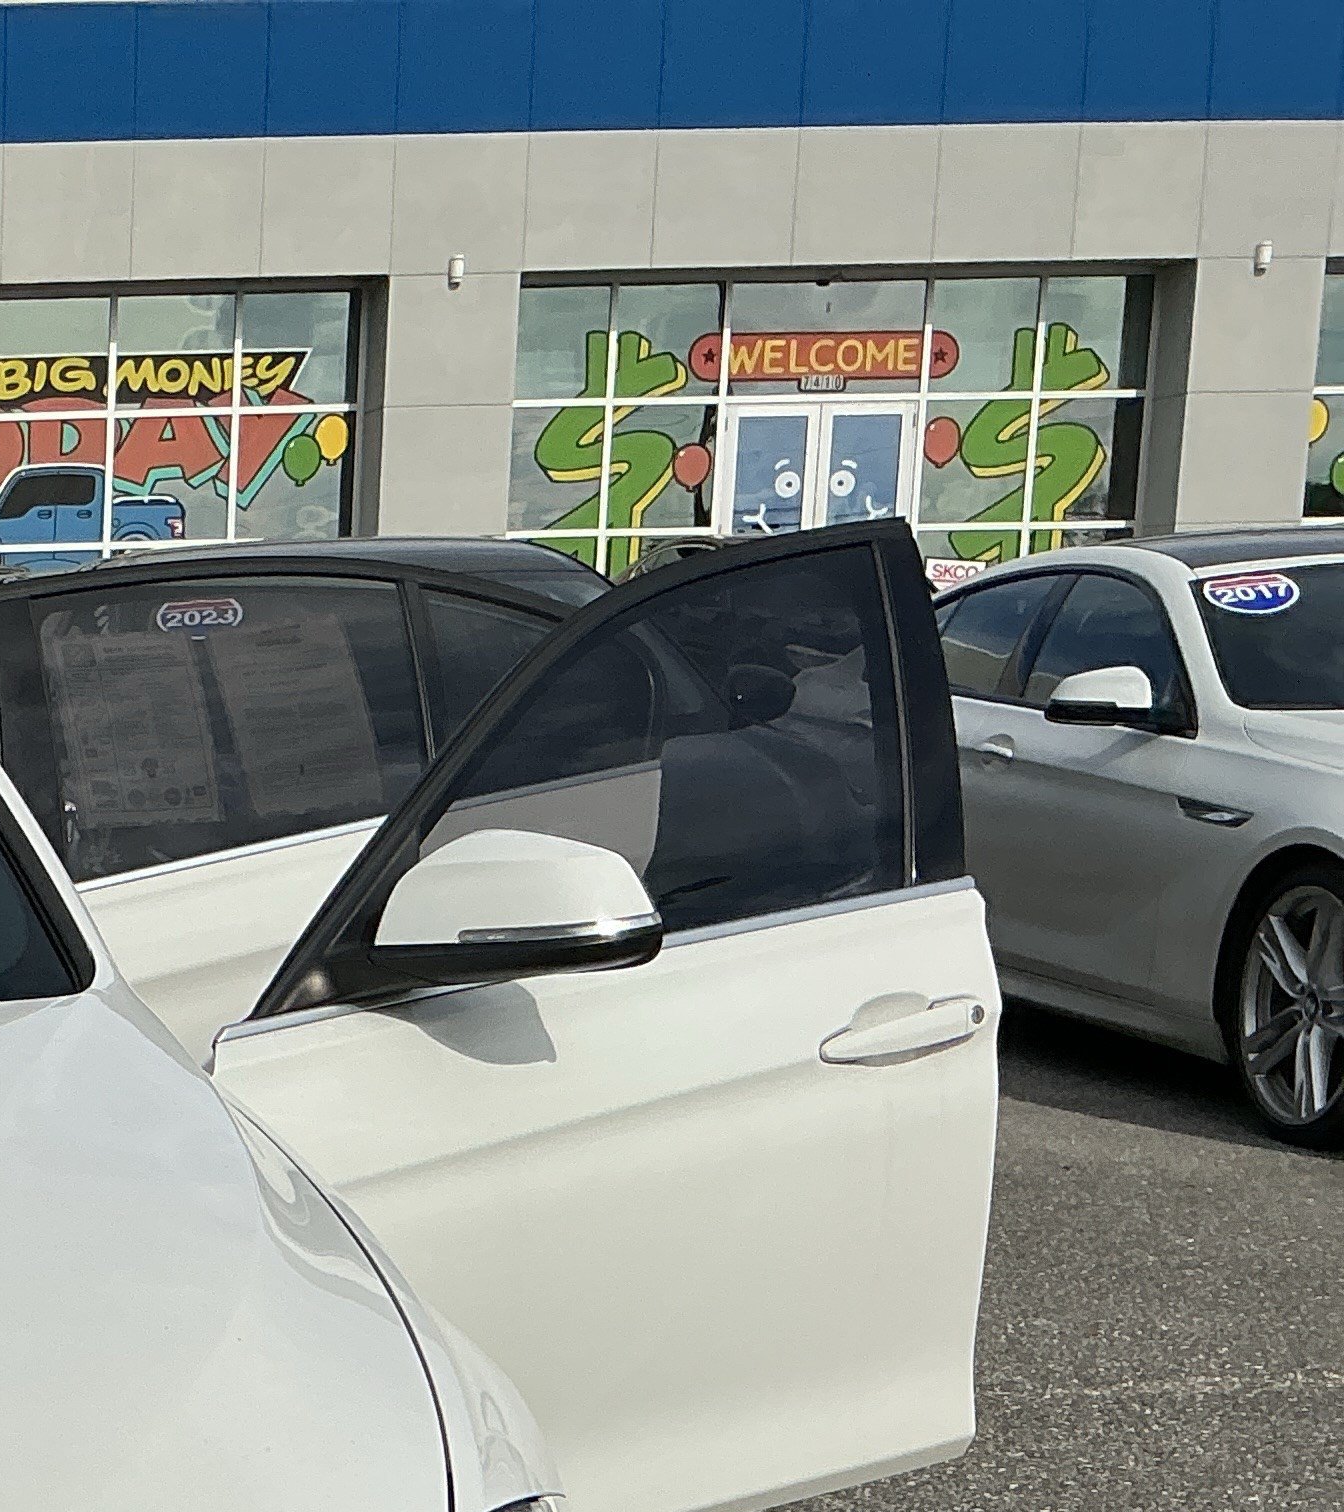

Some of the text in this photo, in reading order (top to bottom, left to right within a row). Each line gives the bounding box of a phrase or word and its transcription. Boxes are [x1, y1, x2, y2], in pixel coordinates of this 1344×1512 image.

[728, 338, 920, 375] WELCOME
[102, 354, 295, 397] MONEY
[800, 375, 844, 390] 7410
[931, 562, 980, 579] SKCO
[1215, 582, 1289, 603] 2017
[165, 609, 235, 627] 2023
